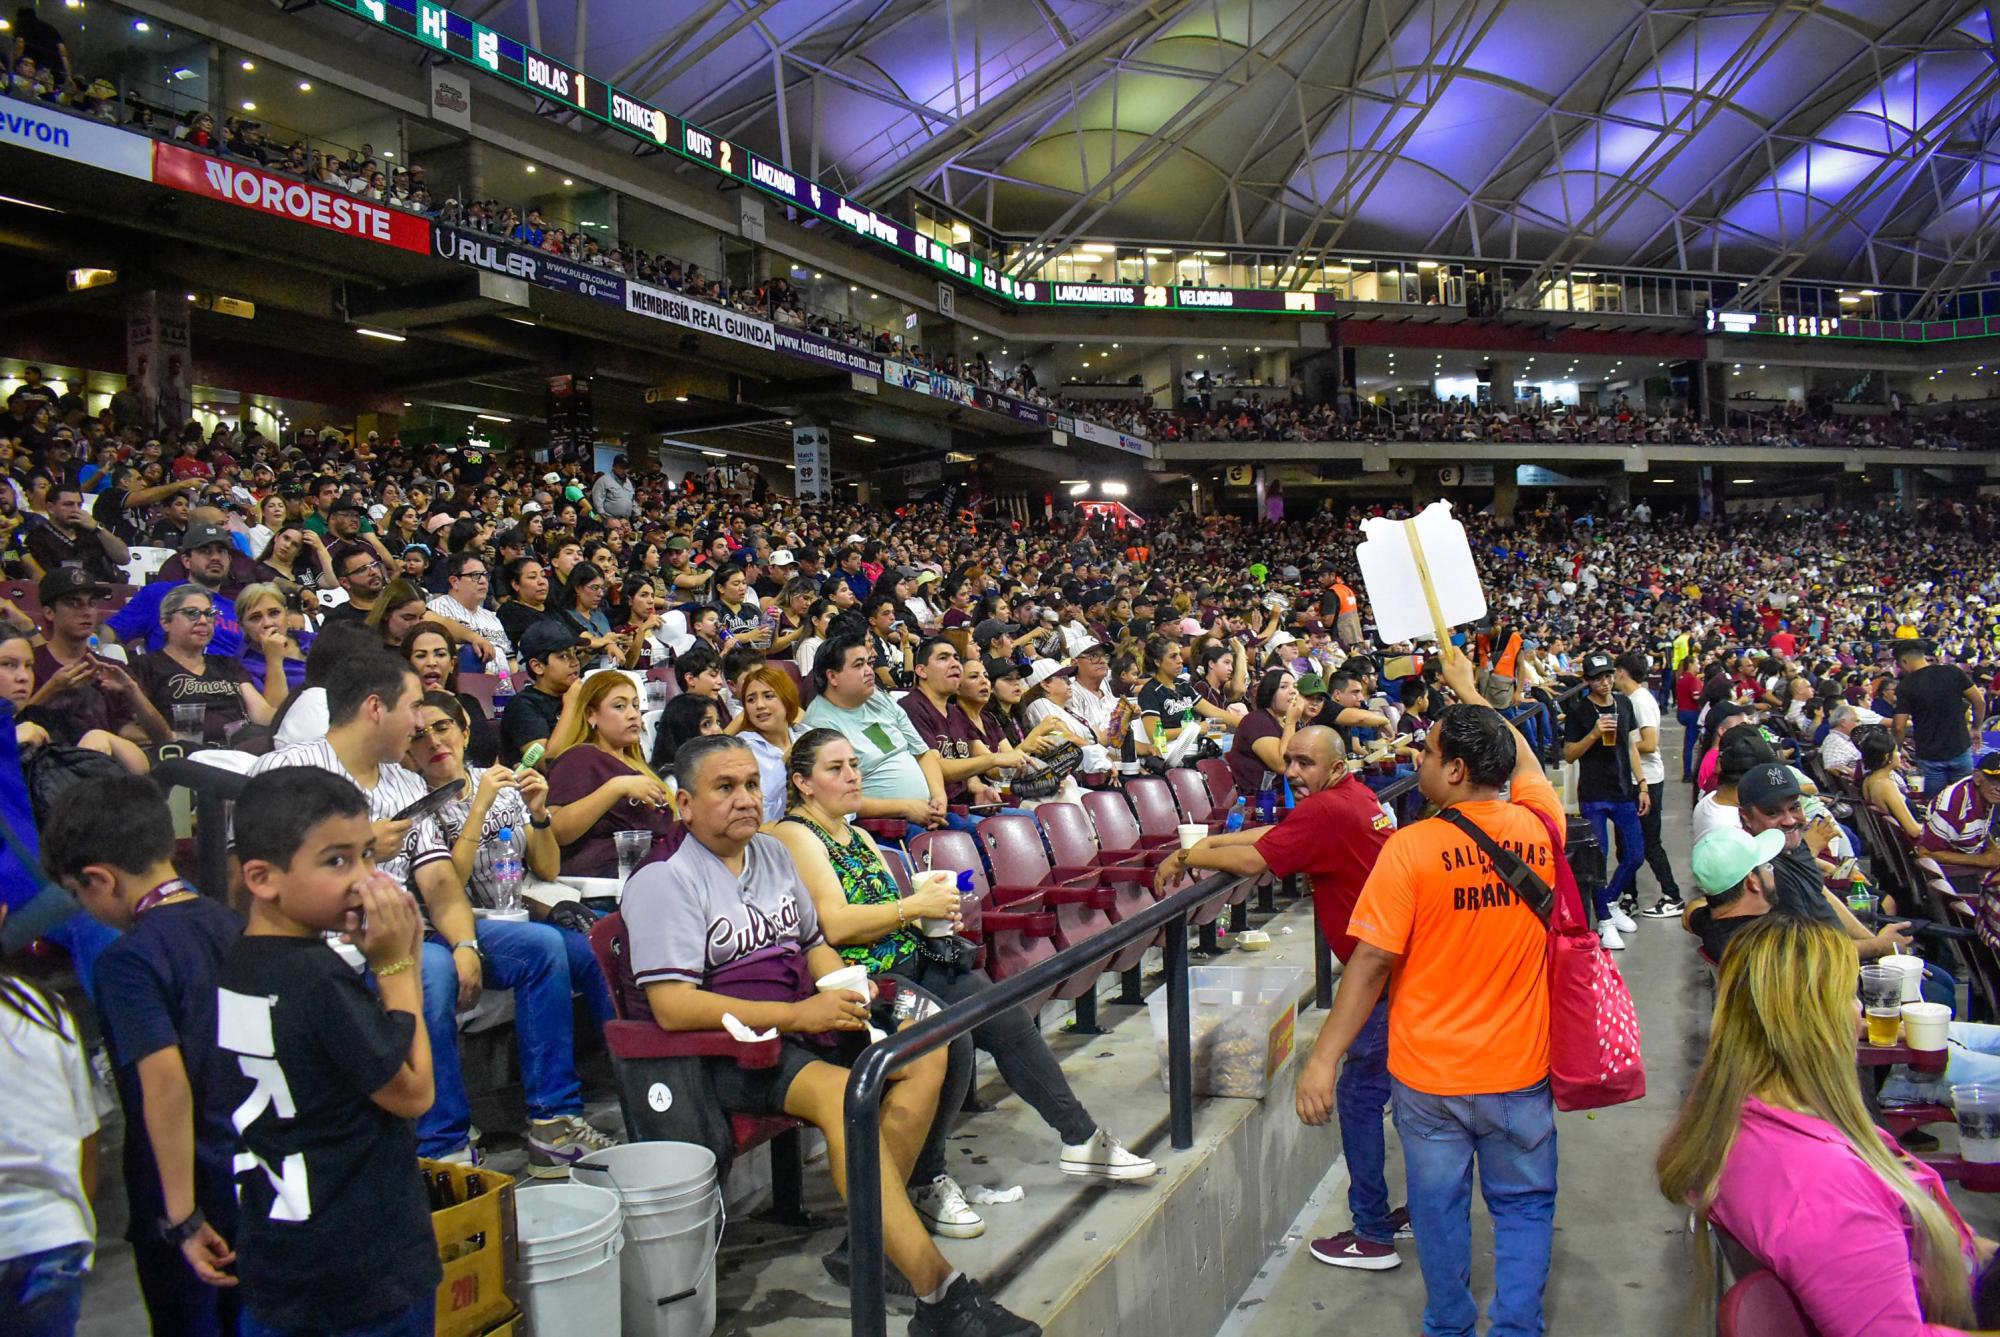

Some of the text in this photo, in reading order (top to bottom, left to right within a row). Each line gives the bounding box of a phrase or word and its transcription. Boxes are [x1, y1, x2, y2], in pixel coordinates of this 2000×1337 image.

[528, 56, 586, 109] BOLAS 1
[612, 94, 657, 135] STRIKES
[686, 128, 732, 174] OUTS 2
[752, 158, 796, 197] LANZADOR
[205, 160, 391, 241] NOROESTE
[459, 238, 537, 281] RULER
[546, 262, 618, 290] WWW.RULER.COM.MX
[1055, 284, 1135, 304] LANZAMIENTOS
[1179, 289, 1233, 306] VELOCIDAD
[632, 290, 690, 322] MEMBRESÍA
[692, 307, 723, 332] REAL
[725, 318, 773, 345] GUINDA
[775, 332, 882, 375] www.tomateros.com.mx
[1441, 840, 1547, 872] SALCHAS
[656, 1091, 664, 1103] A
